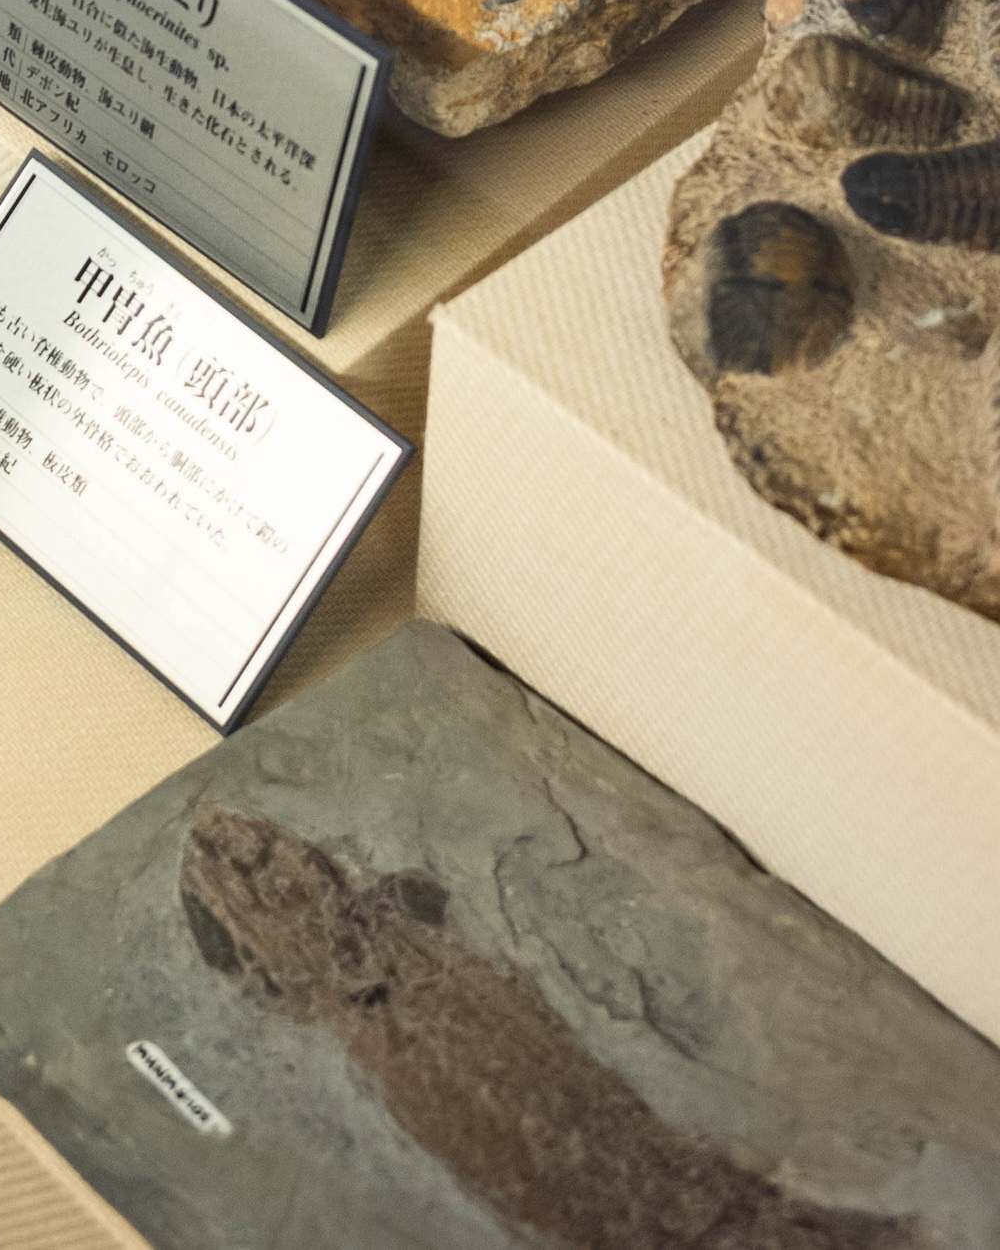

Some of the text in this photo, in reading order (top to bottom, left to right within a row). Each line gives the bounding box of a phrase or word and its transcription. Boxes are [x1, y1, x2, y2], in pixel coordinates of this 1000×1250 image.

[26, 65, 80, 114] デボン紀
[208, 48, 229, 72] sp.
[20, 88, 87, 145] 北アフリカ
[102, 149, 157, 194] モロッコ
[63, 310, 237, 461] Bothriolepis canadensis
